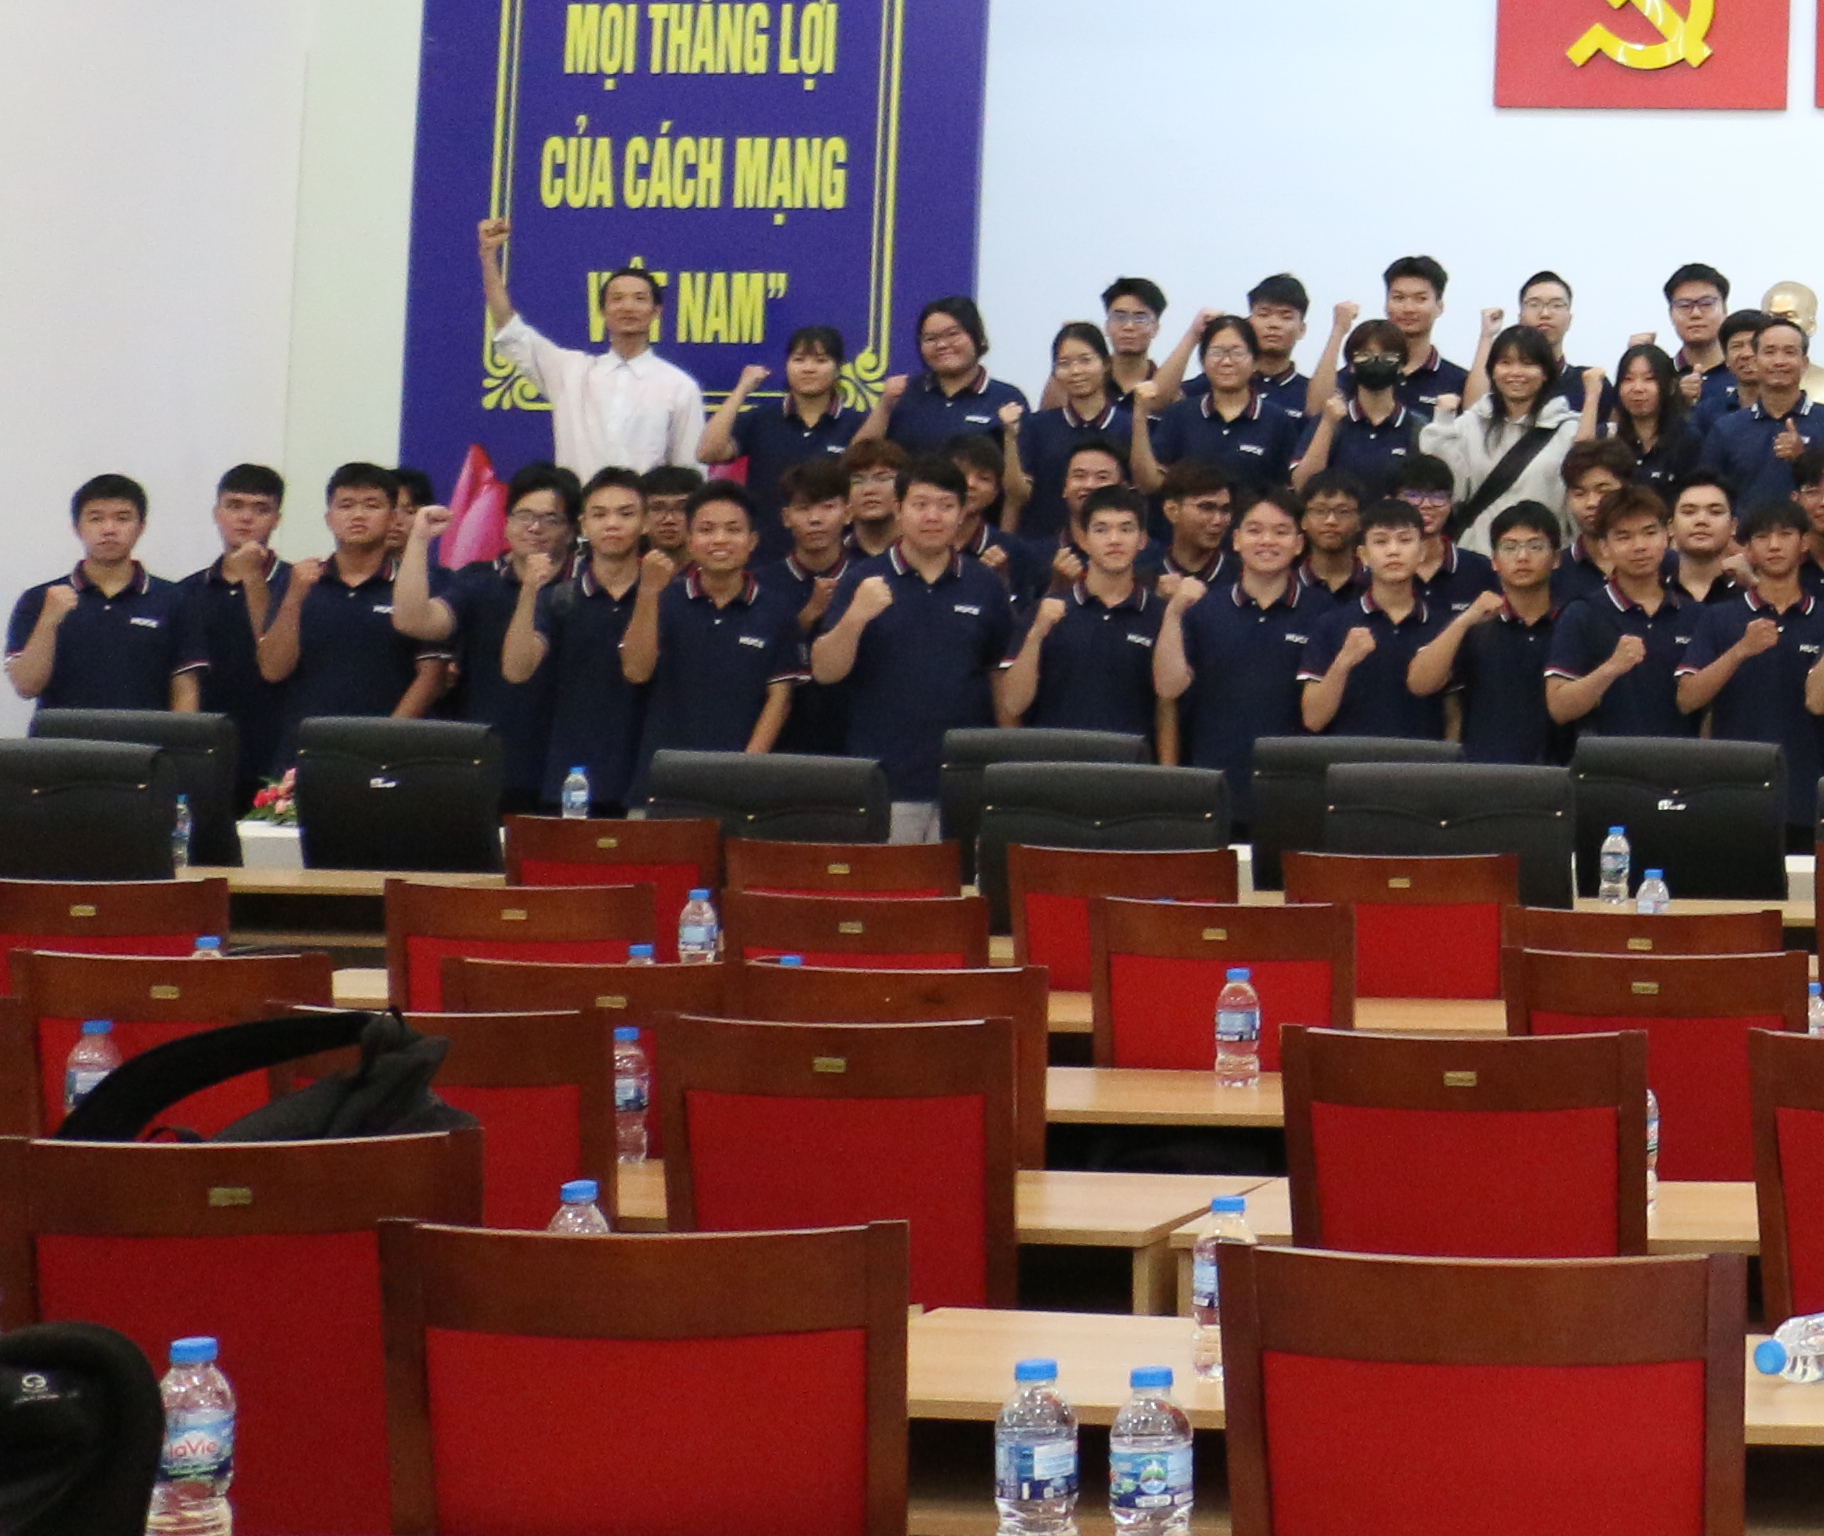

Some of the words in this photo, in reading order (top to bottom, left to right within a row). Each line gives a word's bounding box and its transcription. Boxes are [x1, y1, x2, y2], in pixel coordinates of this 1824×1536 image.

[564, 3, 638, 89] MỌI
[541, 115, 614, 208] CỦA
[623, 122, 723, 208] CÁCH
[734, 137, 847, 224] MẠNG
[677, 272, 787, 343] NAM”
[169, 1439, 218, 1458] laVie
